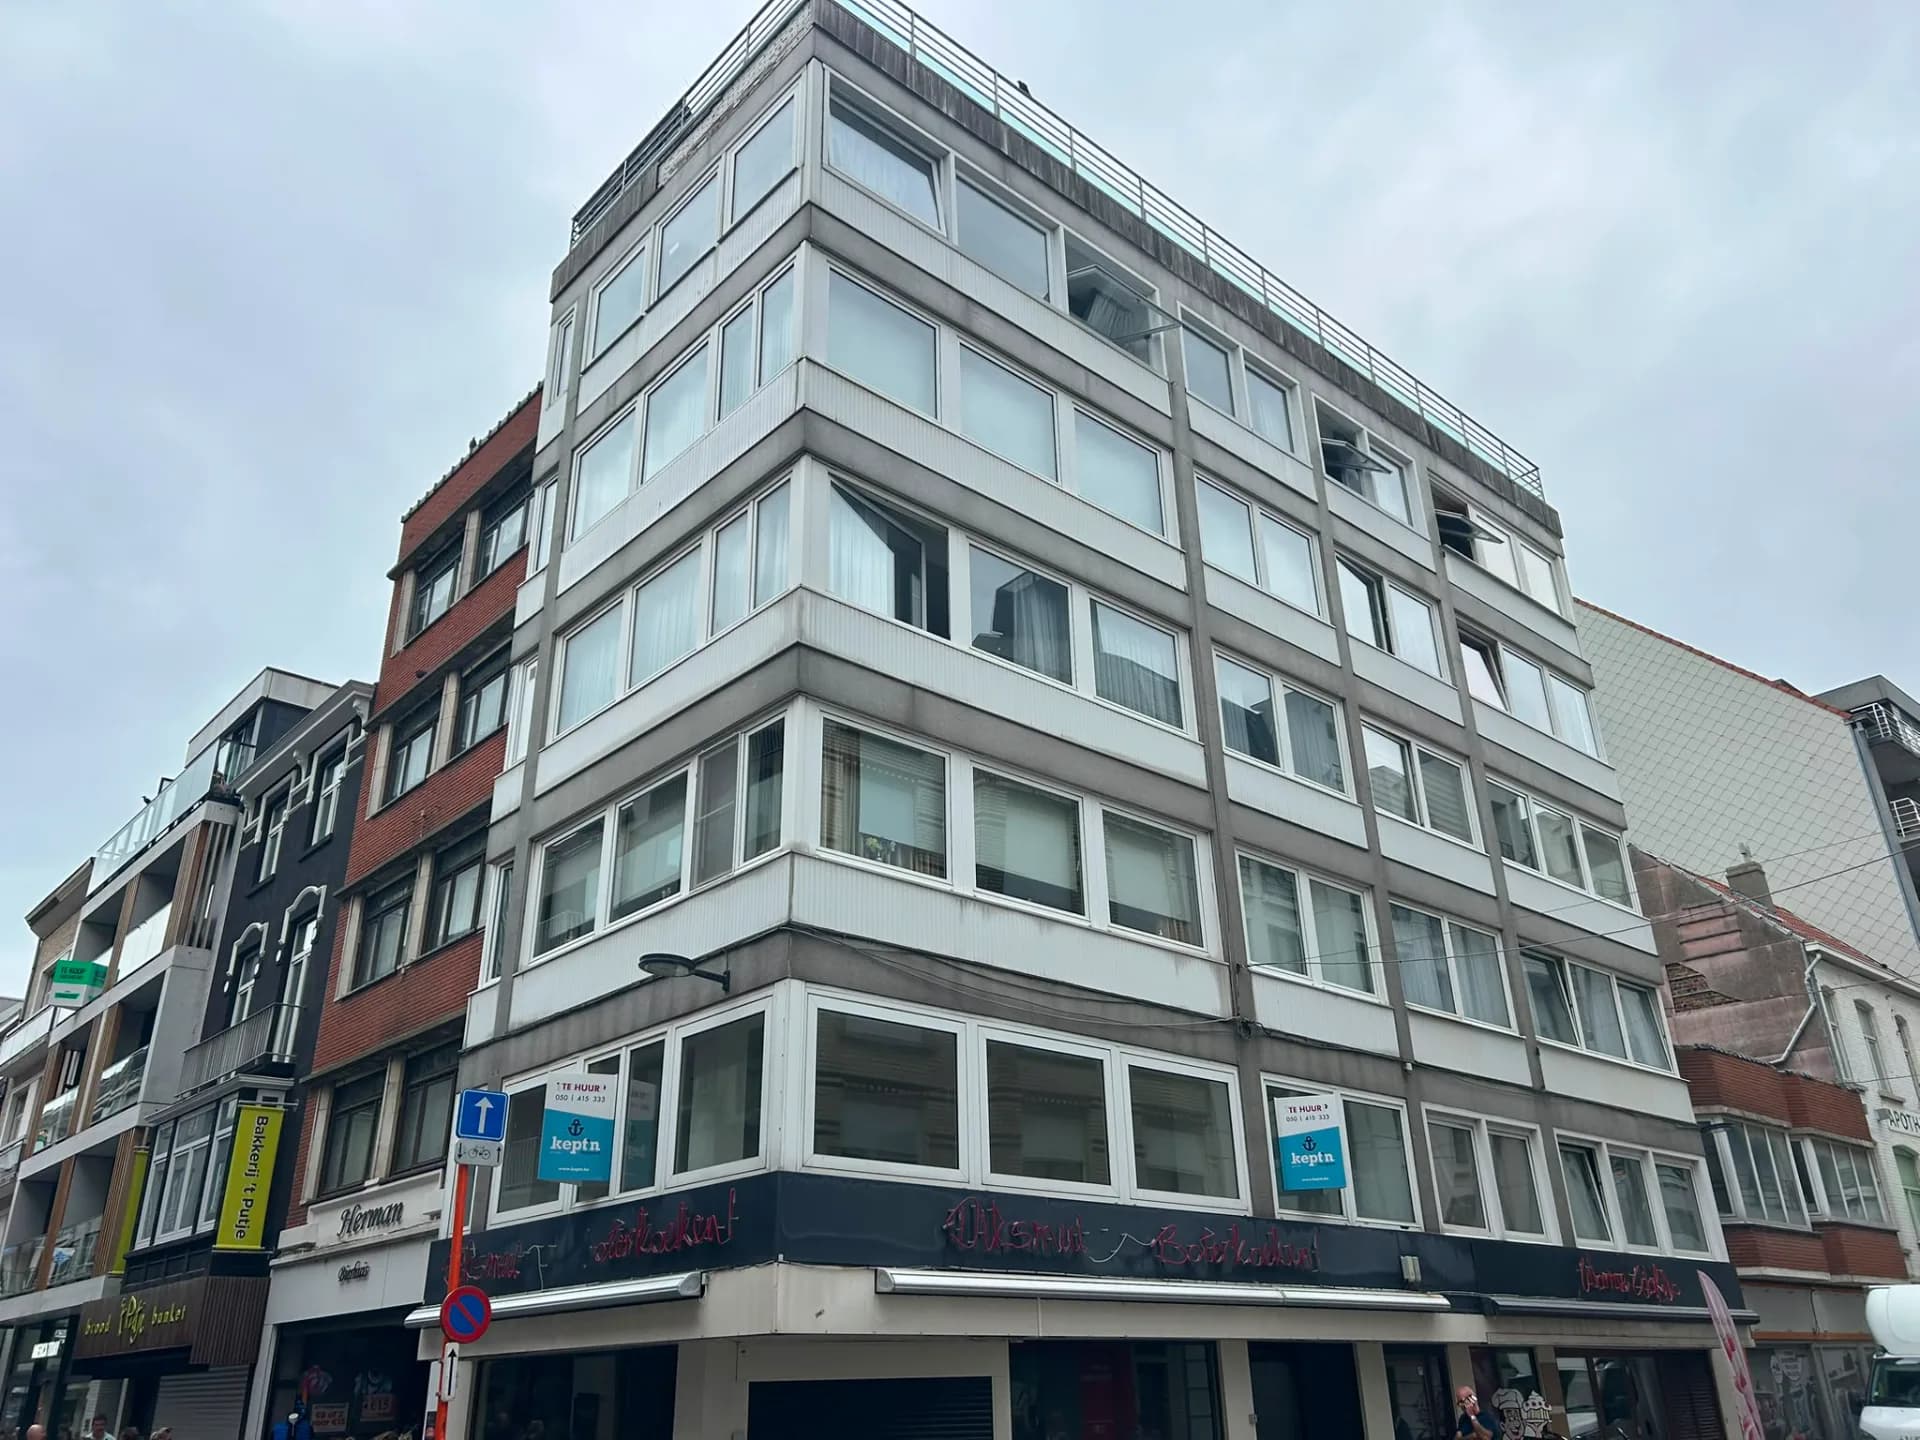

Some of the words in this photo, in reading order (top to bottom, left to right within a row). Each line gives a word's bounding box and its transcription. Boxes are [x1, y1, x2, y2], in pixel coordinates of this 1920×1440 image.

[574, 1084, 600, 1093] HUUR
[1288, 1106, 1296, 1114] TE
[1299, 1105, 1322, 1113] HUUR
[244, 1115, 269, 1178] Bakkerij
[235, 1198, 254, 1239] Putje
[337, 1201, 404, 1237] Herman
